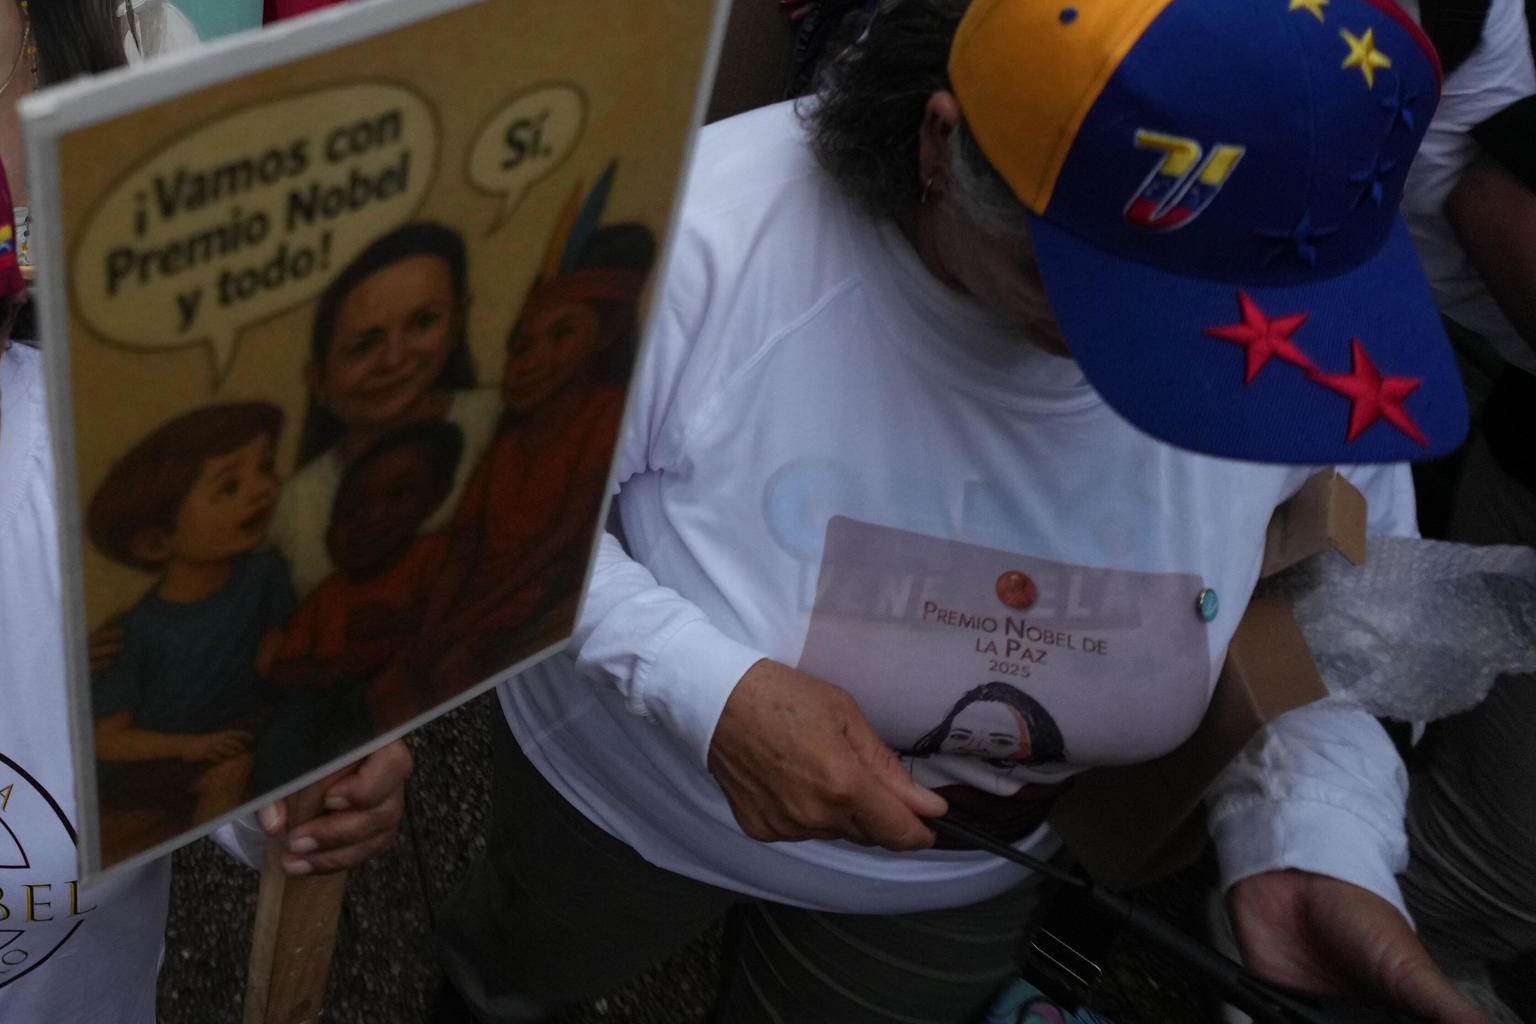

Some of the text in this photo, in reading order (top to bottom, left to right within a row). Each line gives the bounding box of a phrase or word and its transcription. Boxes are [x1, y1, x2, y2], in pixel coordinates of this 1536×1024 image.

[105, 152, 411, 295] Premio Nobel
[135, 109, 402, 236] ¡Vamos con
[175, 229, 332, 332] y todo!
[988, 659, 1032, 678] 2025
